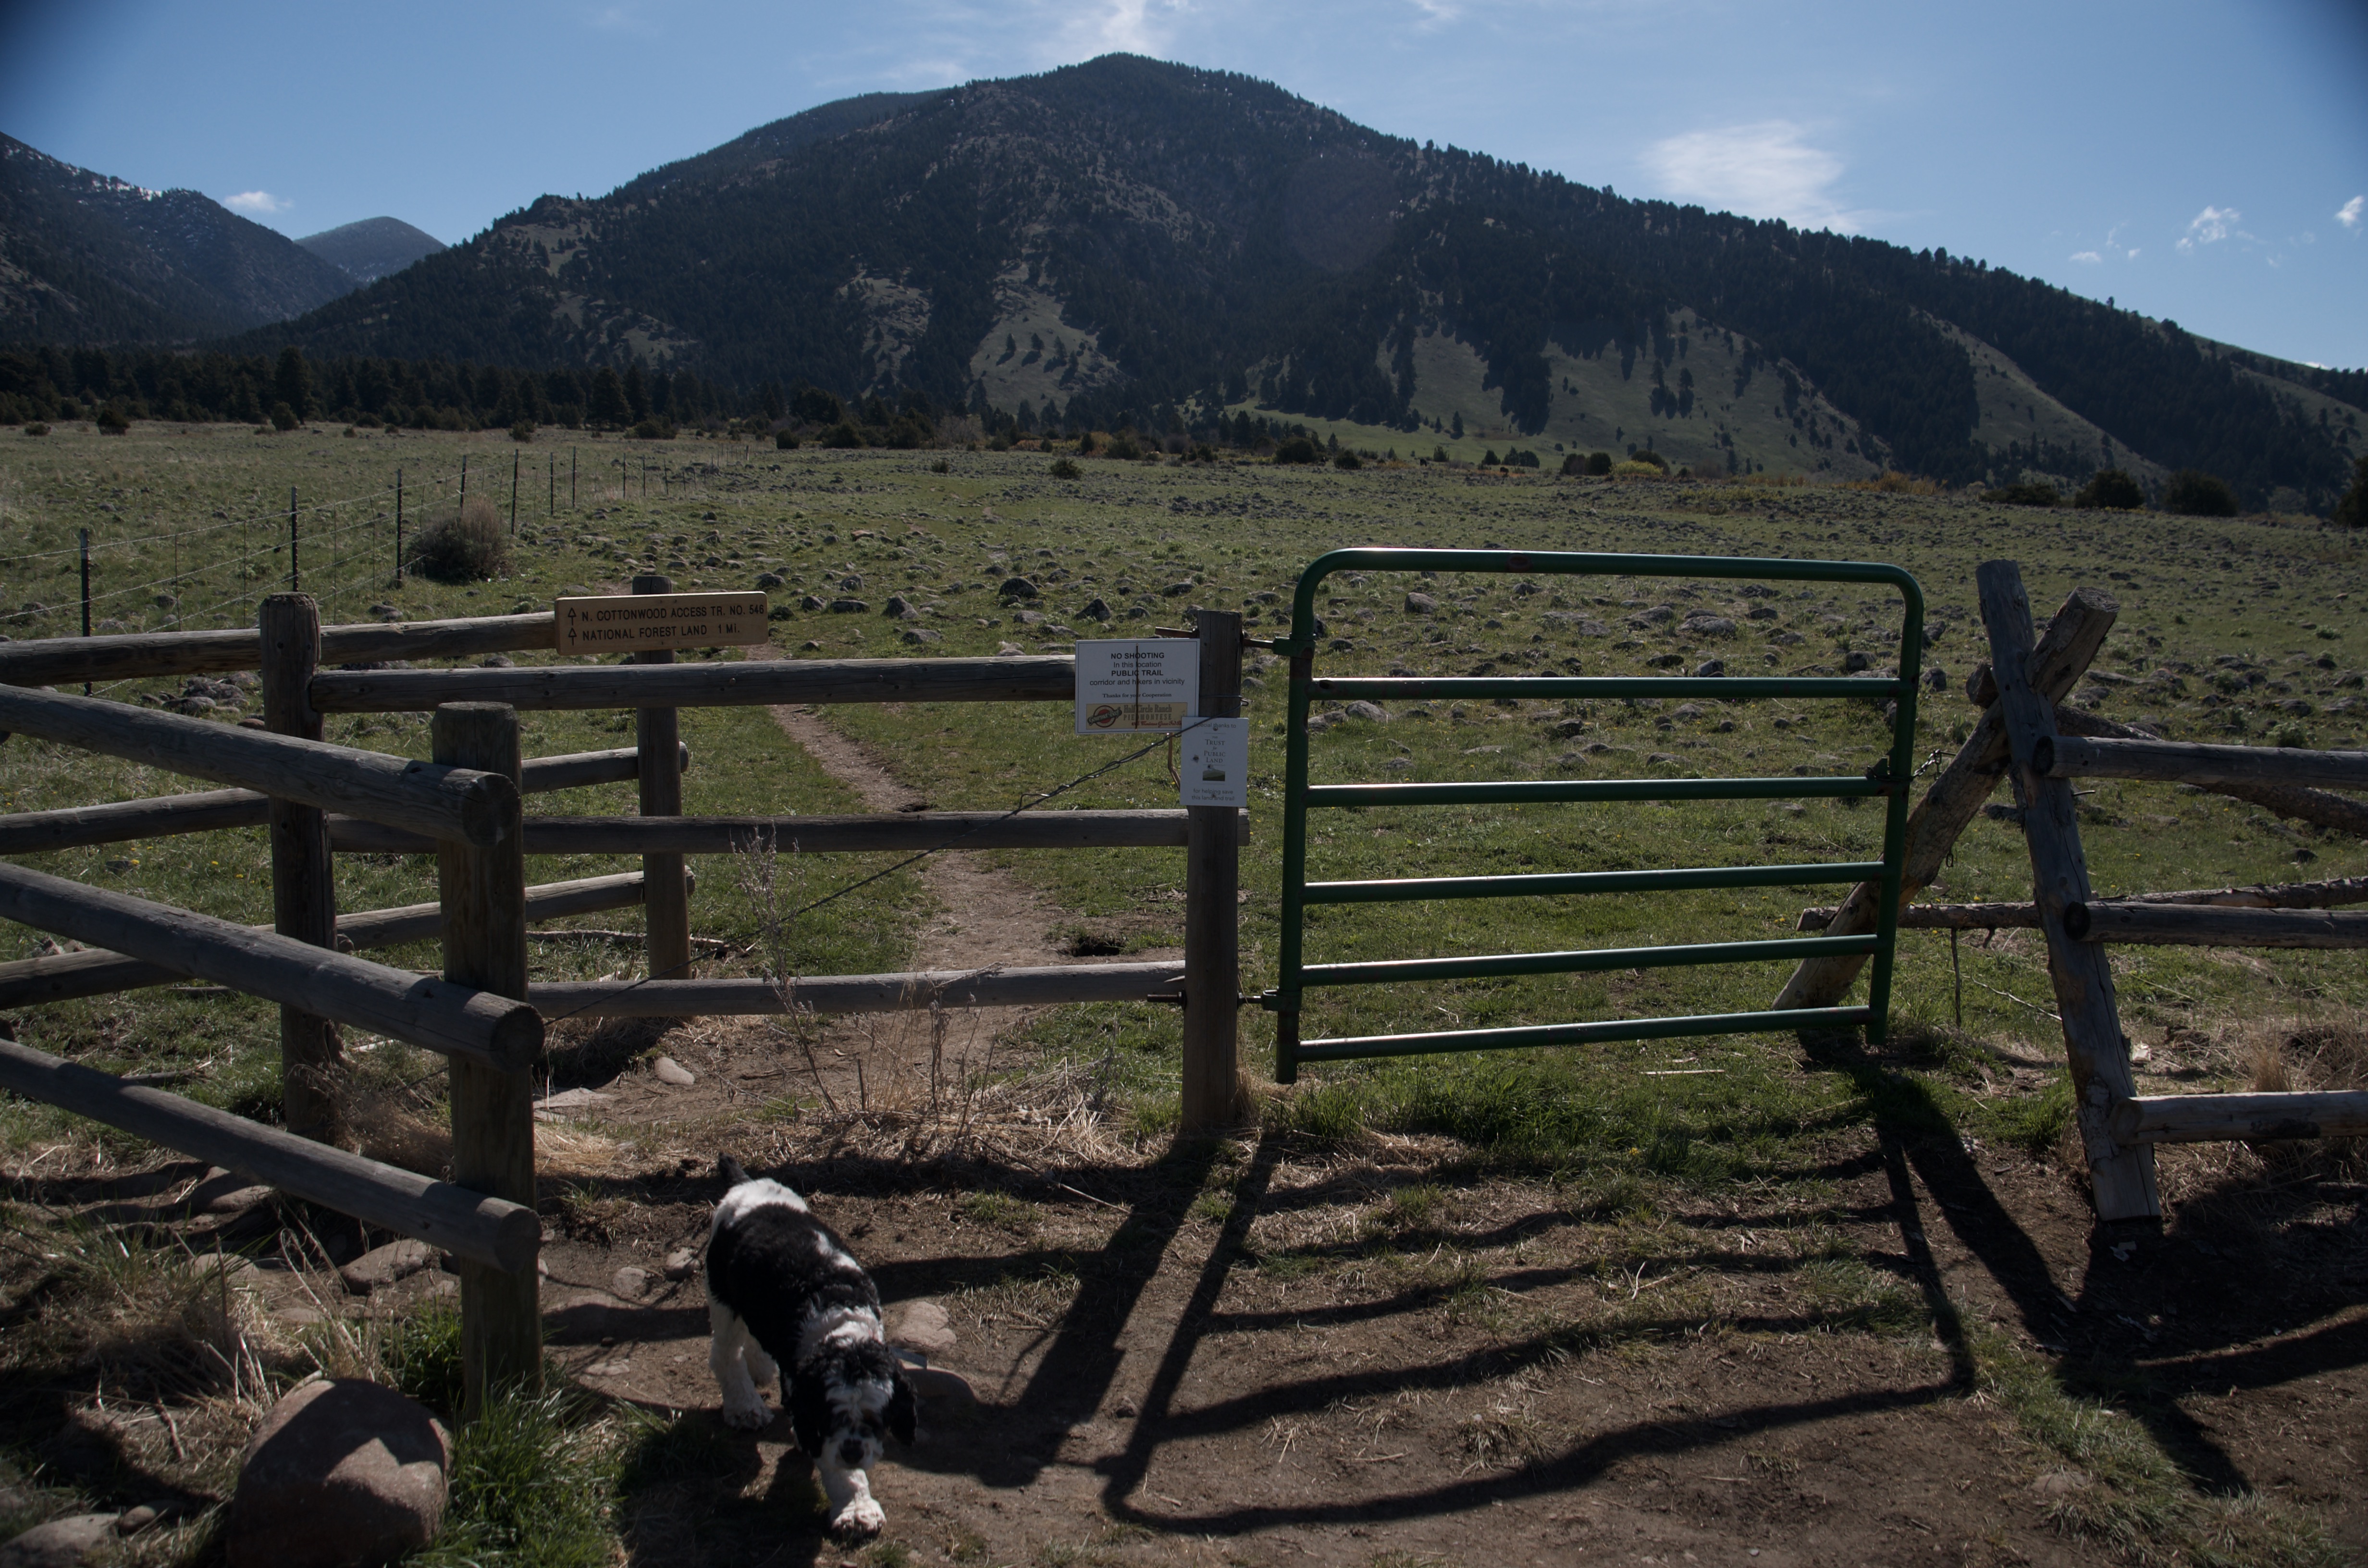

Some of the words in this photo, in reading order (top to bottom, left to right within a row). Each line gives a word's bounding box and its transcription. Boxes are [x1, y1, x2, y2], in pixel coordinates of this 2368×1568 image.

[582, 612, 592, 622] N.
[597, 608, 667, 621] COTTONWOOD
[671, 607, 707, 618] ACCESS
[710, 606, 725, 616] TR.
[730, 605, 745, 615] NO.
[749, 604, 764, 614] 546
[583, 629, 634, 641] NATIONAL
[640, 626, 677, 638] FOREST
[681, 625, 707, 636] LAND
[718, 625, 721, 634] 1
[1162, 678, 1185, 686] vicinity
[1124, 704, 1136, 713] Half
[1154, 704, 1172, 712] Ranch
